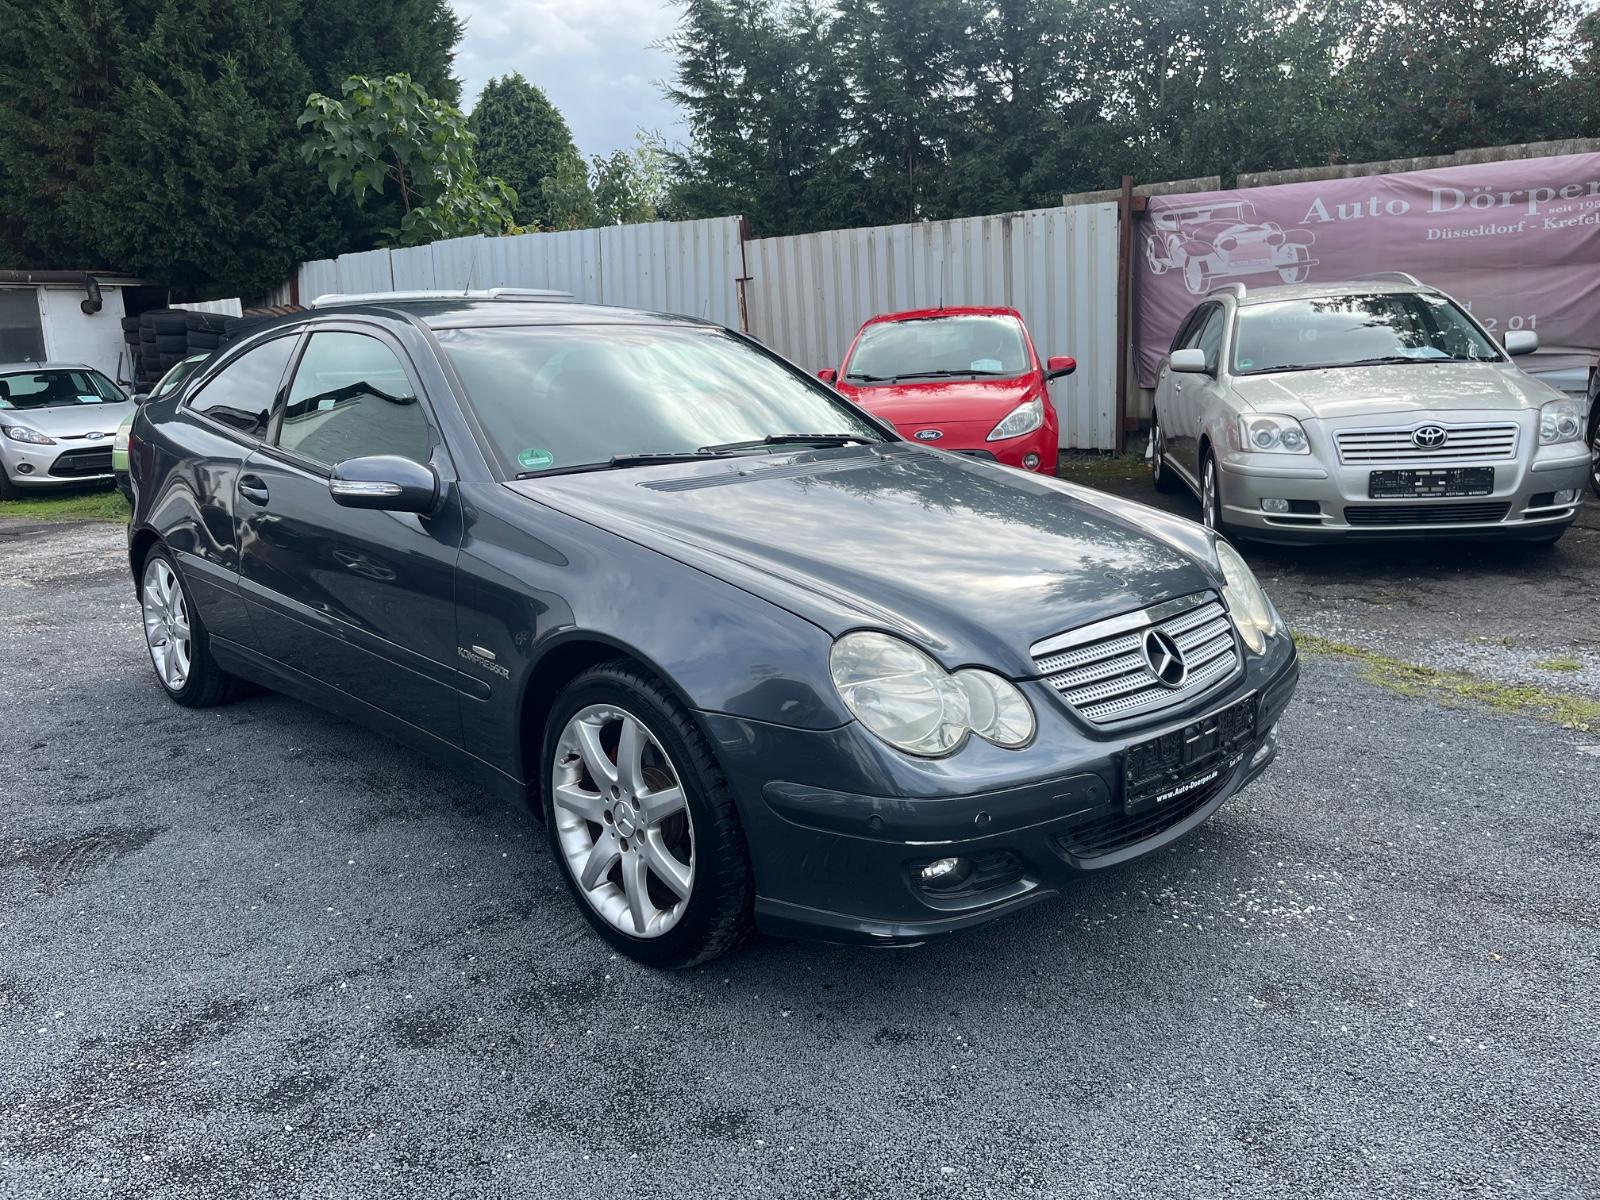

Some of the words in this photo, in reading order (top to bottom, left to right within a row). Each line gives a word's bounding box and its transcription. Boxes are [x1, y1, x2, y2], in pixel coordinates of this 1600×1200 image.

[1298, 196, 1410, 224] Auto
[1548, 204, 1572, 214] seit
[1426, 221, 1526, 240] Düsseldorf
[1508, 314, 1537, 330] 01
